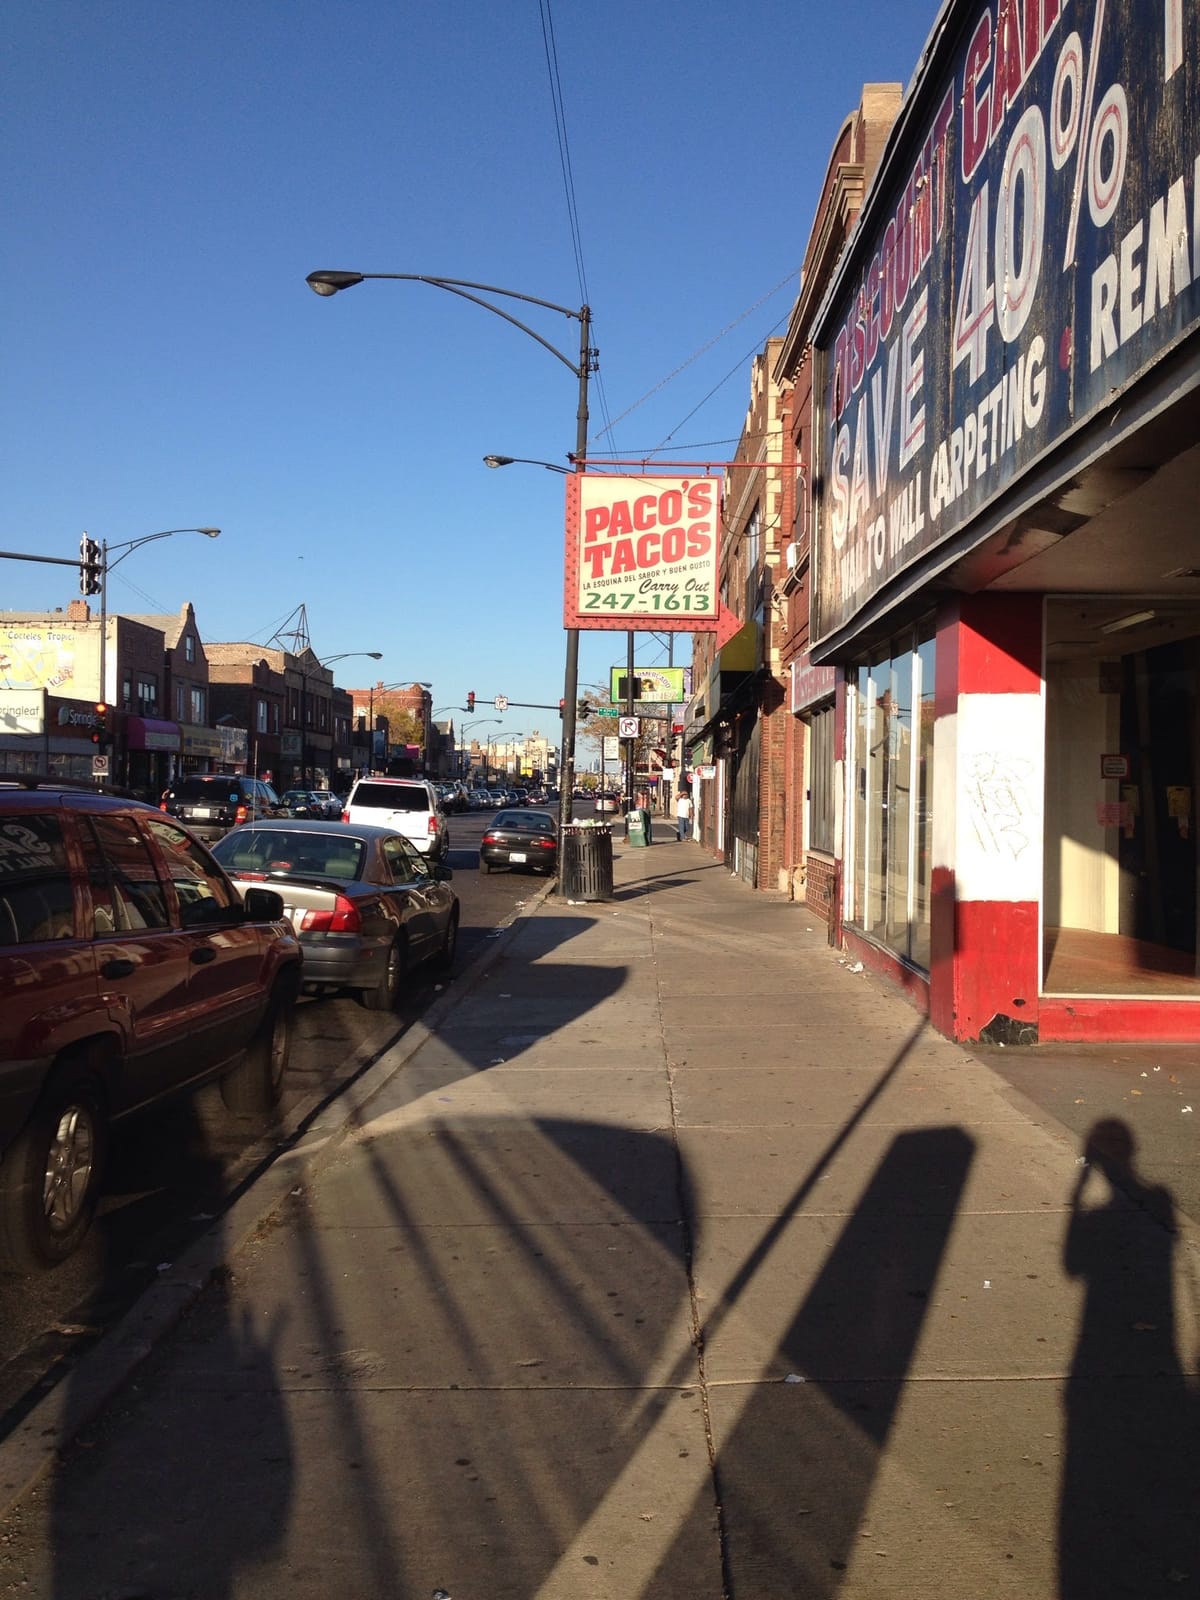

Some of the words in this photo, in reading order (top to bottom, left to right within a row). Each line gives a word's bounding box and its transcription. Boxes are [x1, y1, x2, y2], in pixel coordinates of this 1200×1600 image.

[831, 78, 954, 424] DISCOUNT
[831, 285, 929, 550] SAVE
[953, 0, 1128, 387] 40%
[1090, 155, 1200, 374] REM
[867, 514, 887, 578] TO
[890, 470, 924, 559] WALL
[929, 335, 1047, 522] CARPETING
[585, 480, 712, 543] PACO'S
[584, 522, 712, 578] TACOS
[593, 577, 622, 589] ESQUINA
[625, 574, 637, 583] DEL
[638, 568, 661, 580] SABOR
[663, 567, 668, 575] Y
[669, 564, 687, 575] BUEN
[689, 560, 711, 570] GUSTO
[585, 592, 710, 611] 247-1613
[639, 578, 679, 595] Carry
[684, 578, 710, 592] Out
